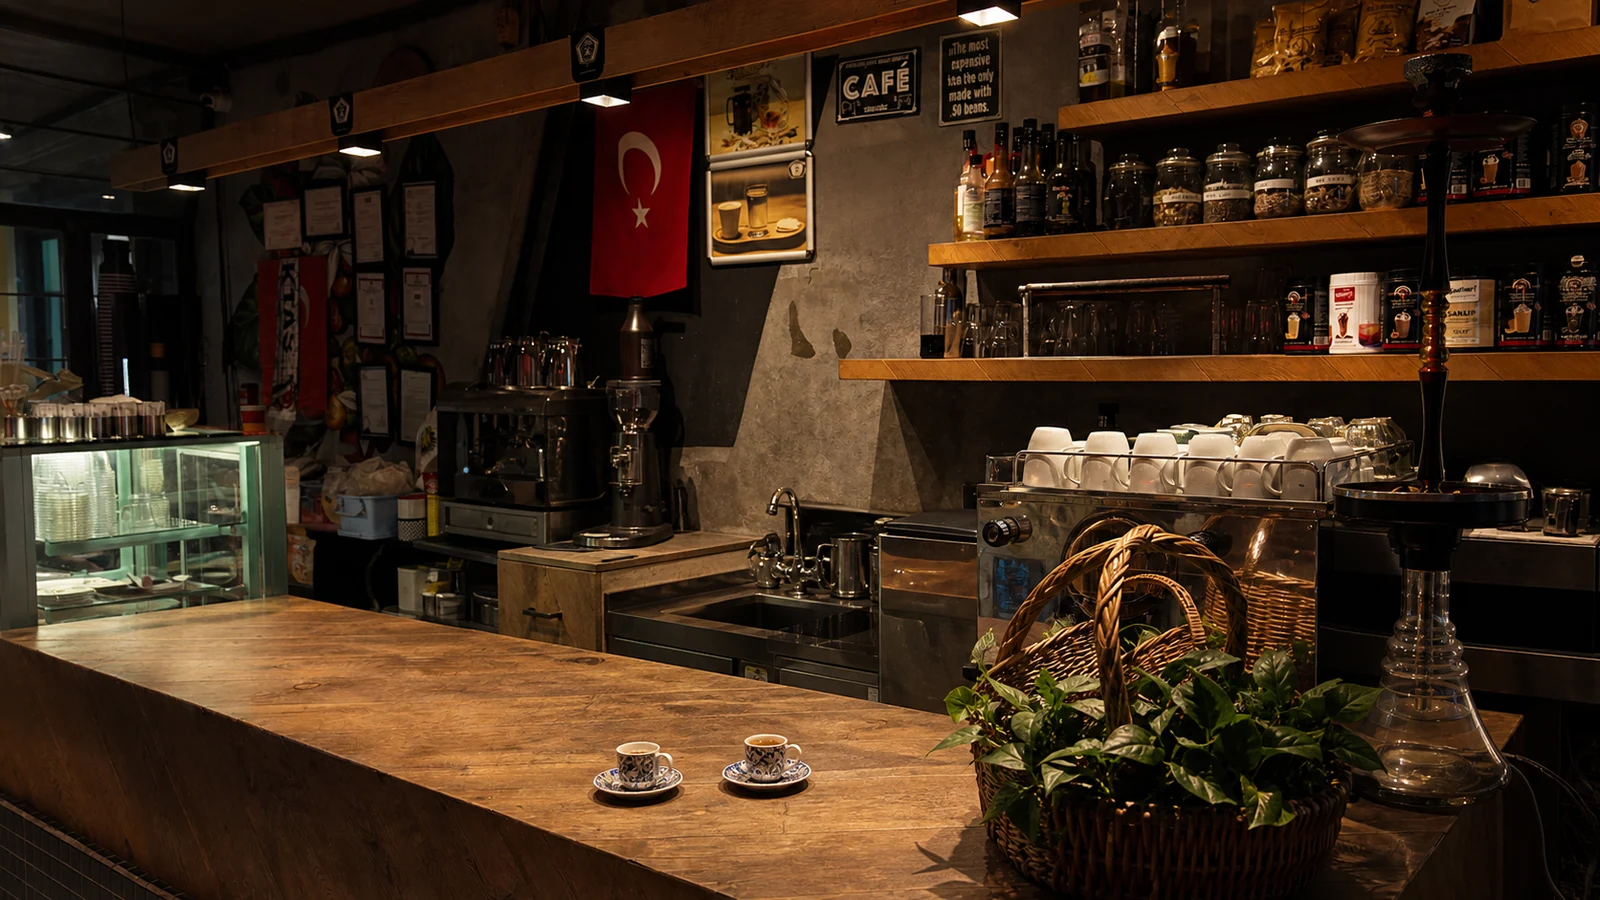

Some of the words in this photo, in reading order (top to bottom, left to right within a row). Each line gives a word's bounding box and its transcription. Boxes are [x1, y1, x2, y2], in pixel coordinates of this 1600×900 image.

[968, 36, 989, 52] most
[843, 61, 910, 100] CAFÉ
[977, 68, 994, 83] only
[948, 87, 972, 102] made
[973, 84, 992, 99] with
